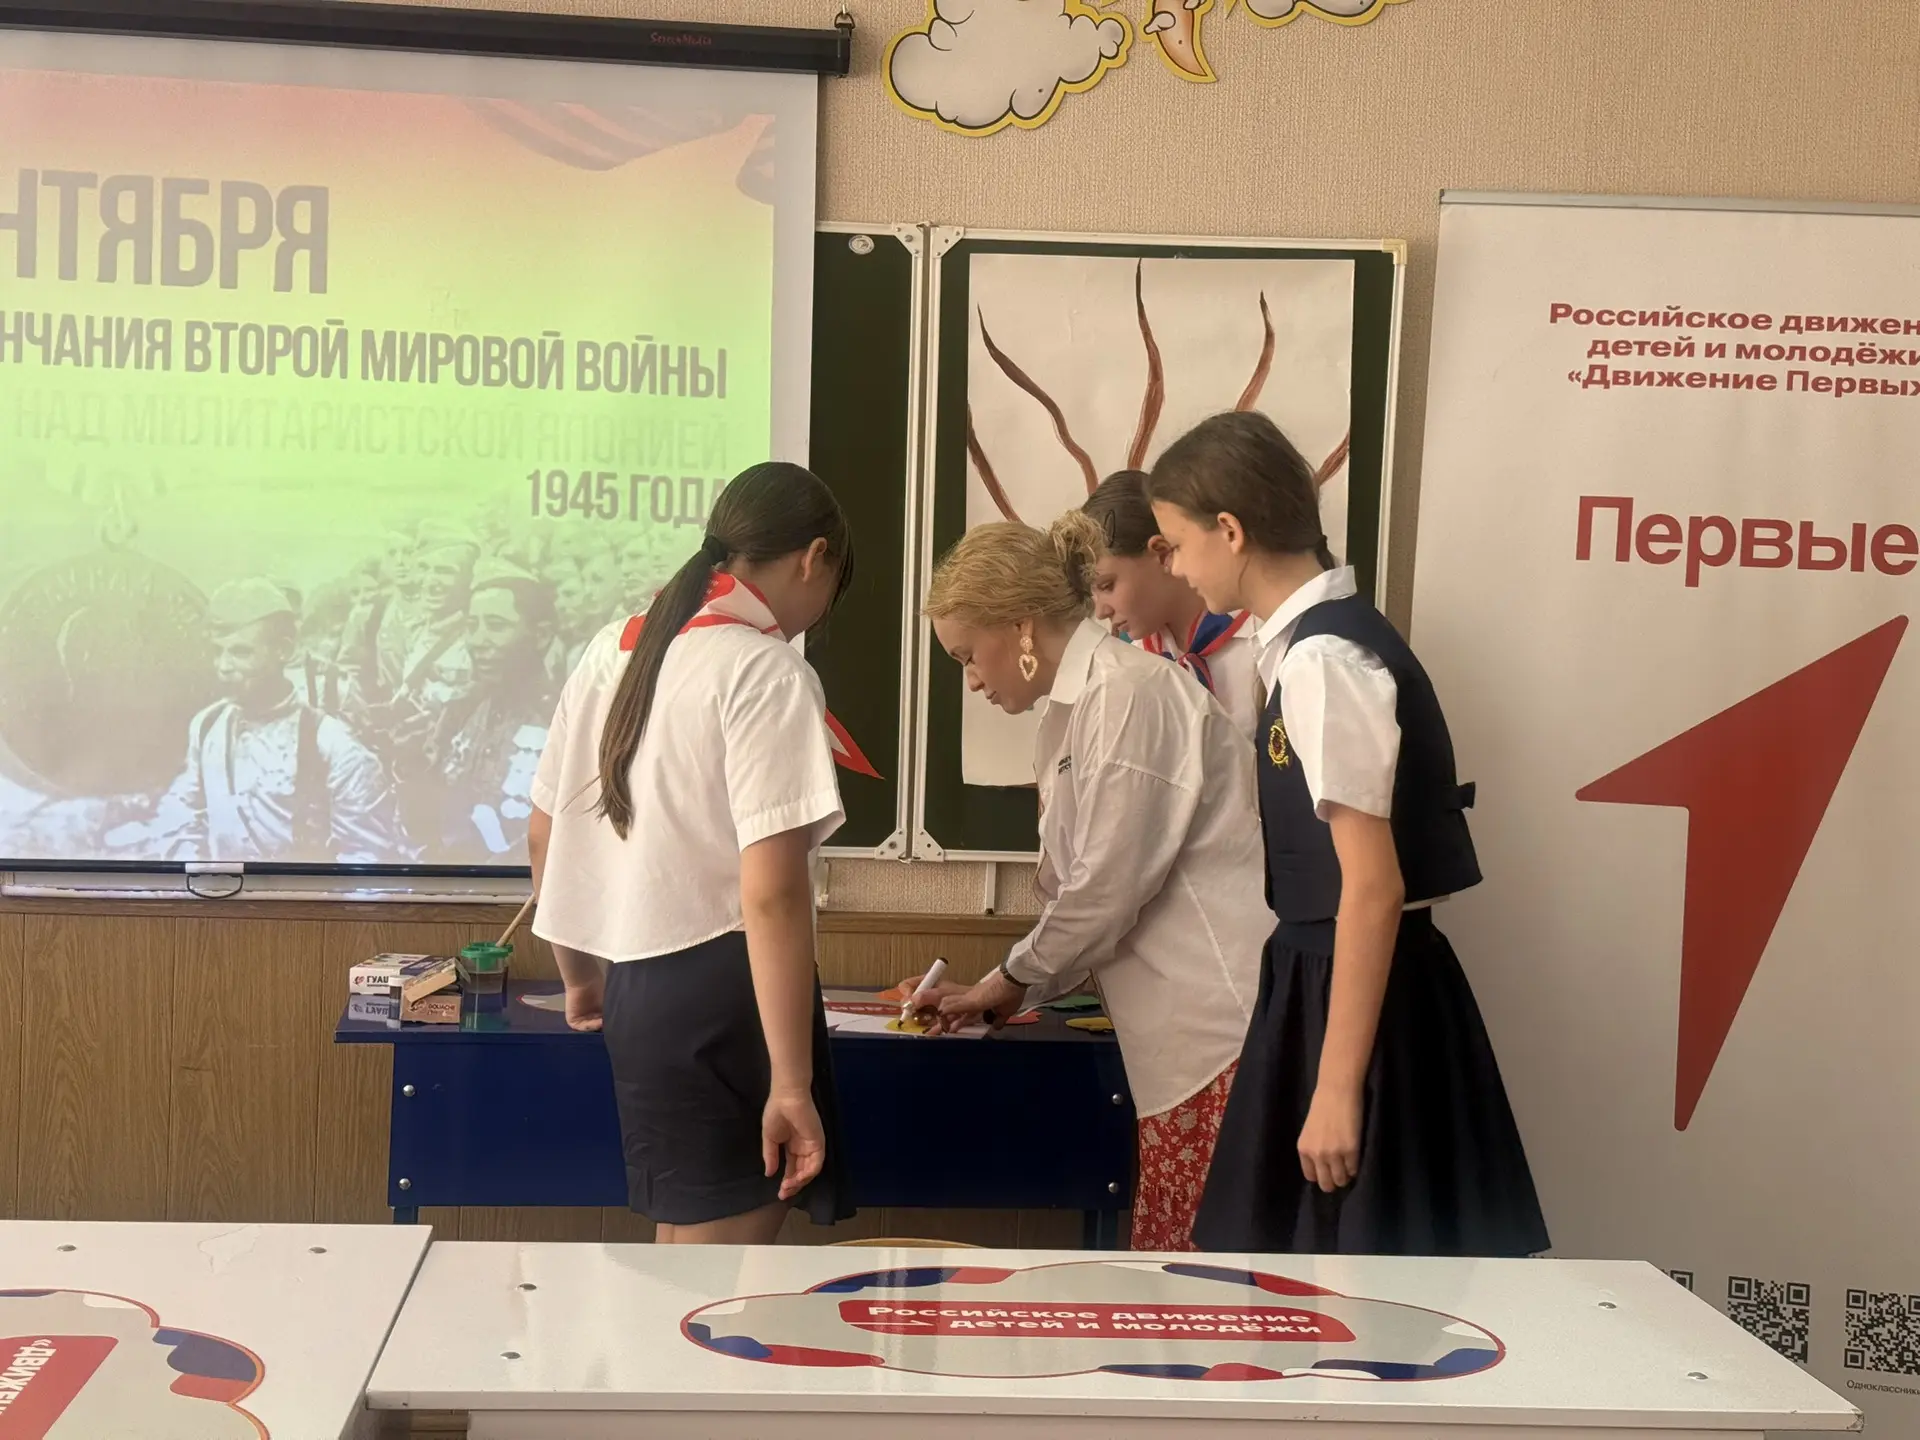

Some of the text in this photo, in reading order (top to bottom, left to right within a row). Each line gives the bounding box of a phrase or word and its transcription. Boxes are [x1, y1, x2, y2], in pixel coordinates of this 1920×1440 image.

[0, 168, 329, 294] НТЯБРЯ
[1549, 302, 1920, 335] Российское движен
[0, 310, 728, 400] НЧАНИЯ ВТОРОЙ МИРОВОЙ ВОЙНЫ
[1586, 335, 1696, 359] детей
[1704, 342, 1727, 358] и
[1567, 363, 1778, 391] «Движение
[14, 387, 728, 471] НАД МИЛИТАРИСТСКОЙ ЯПОНИЕЙ
[526, 468, 619, 519] 1945
[1575, 494, 1919, 588] Первые
[868, 1306, 1311, 1323] Российское движение
[950, 1319, 1322, 1334] детей и молодёжи
